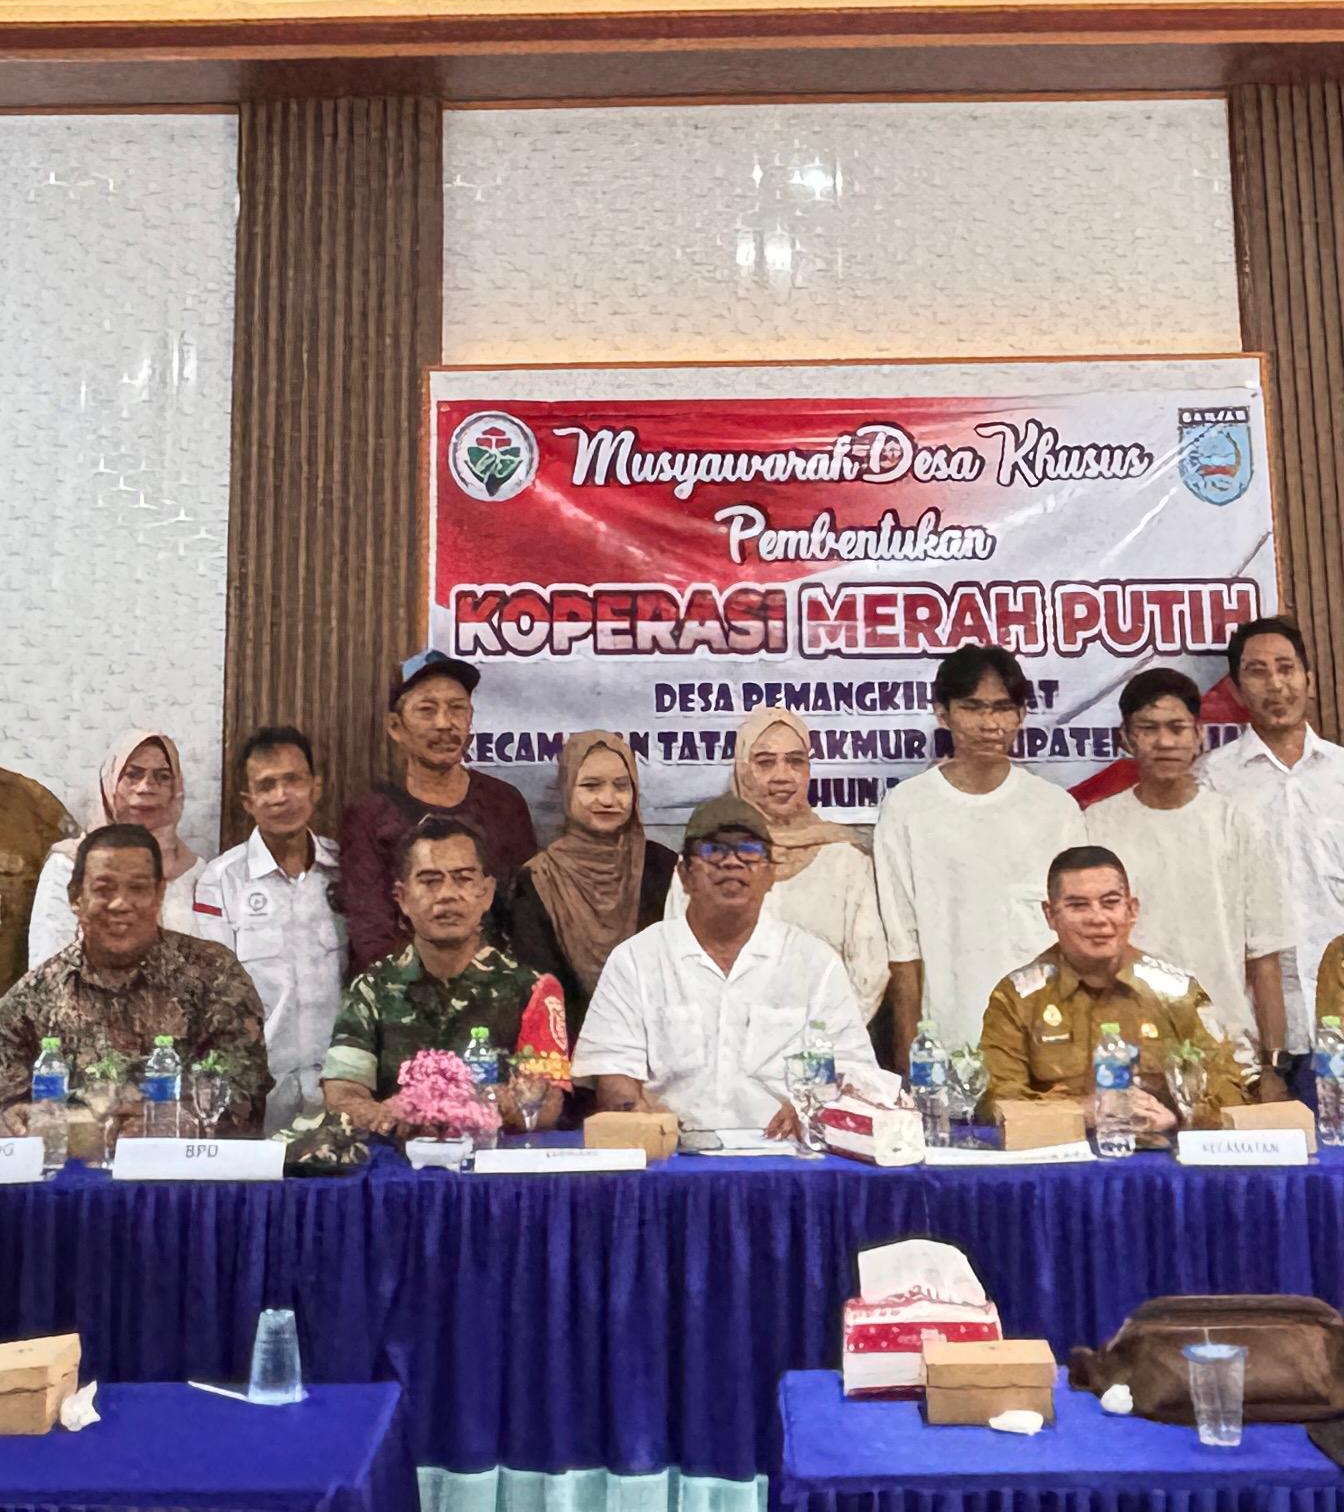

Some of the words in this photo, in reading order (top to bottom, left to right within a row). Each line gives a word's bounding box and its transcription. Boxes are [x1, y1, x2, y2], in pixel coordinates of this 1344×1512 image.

[553, 425, 858, 500] Musyawarah
[855, 423, 984, 484] Desa
[975, 420, 1154, 486] Khusus
[714, 504, 996, 565] Pembentukan
[453, 586, 791, 658] KOPERASI
[803, 585, 1046, 655] MERAH
[1058, 584, 1257, 654] PUTIH
[654, 682, 734, 713] DESA
[657, 730, 738, 761] TATA
[808, 728, 927, 760] AKMUR
[808, 777, 879, 808] HUN
[185, 1144, 219, 1158] BPD
